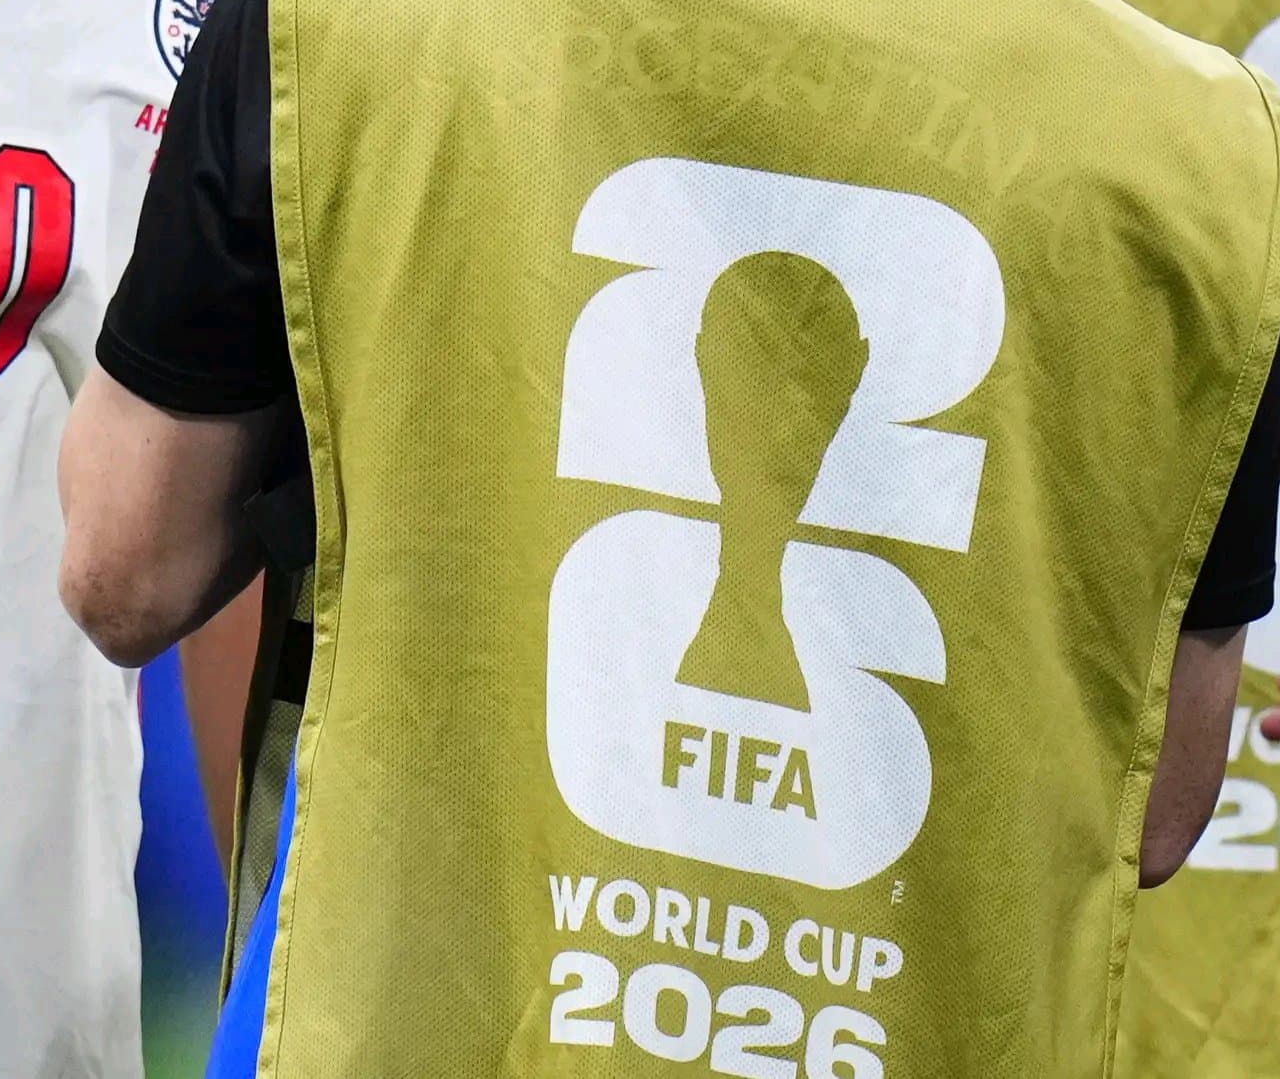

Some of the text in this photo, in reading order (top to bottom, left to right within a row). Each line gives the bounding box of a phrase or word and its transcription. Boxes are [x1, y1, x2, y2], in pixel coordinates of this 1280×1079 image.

[661, 720, 818, 821] FIFA
[548, 875, 904, 993] WORLD CUP
[548, 950, 888, 1079] 2026
